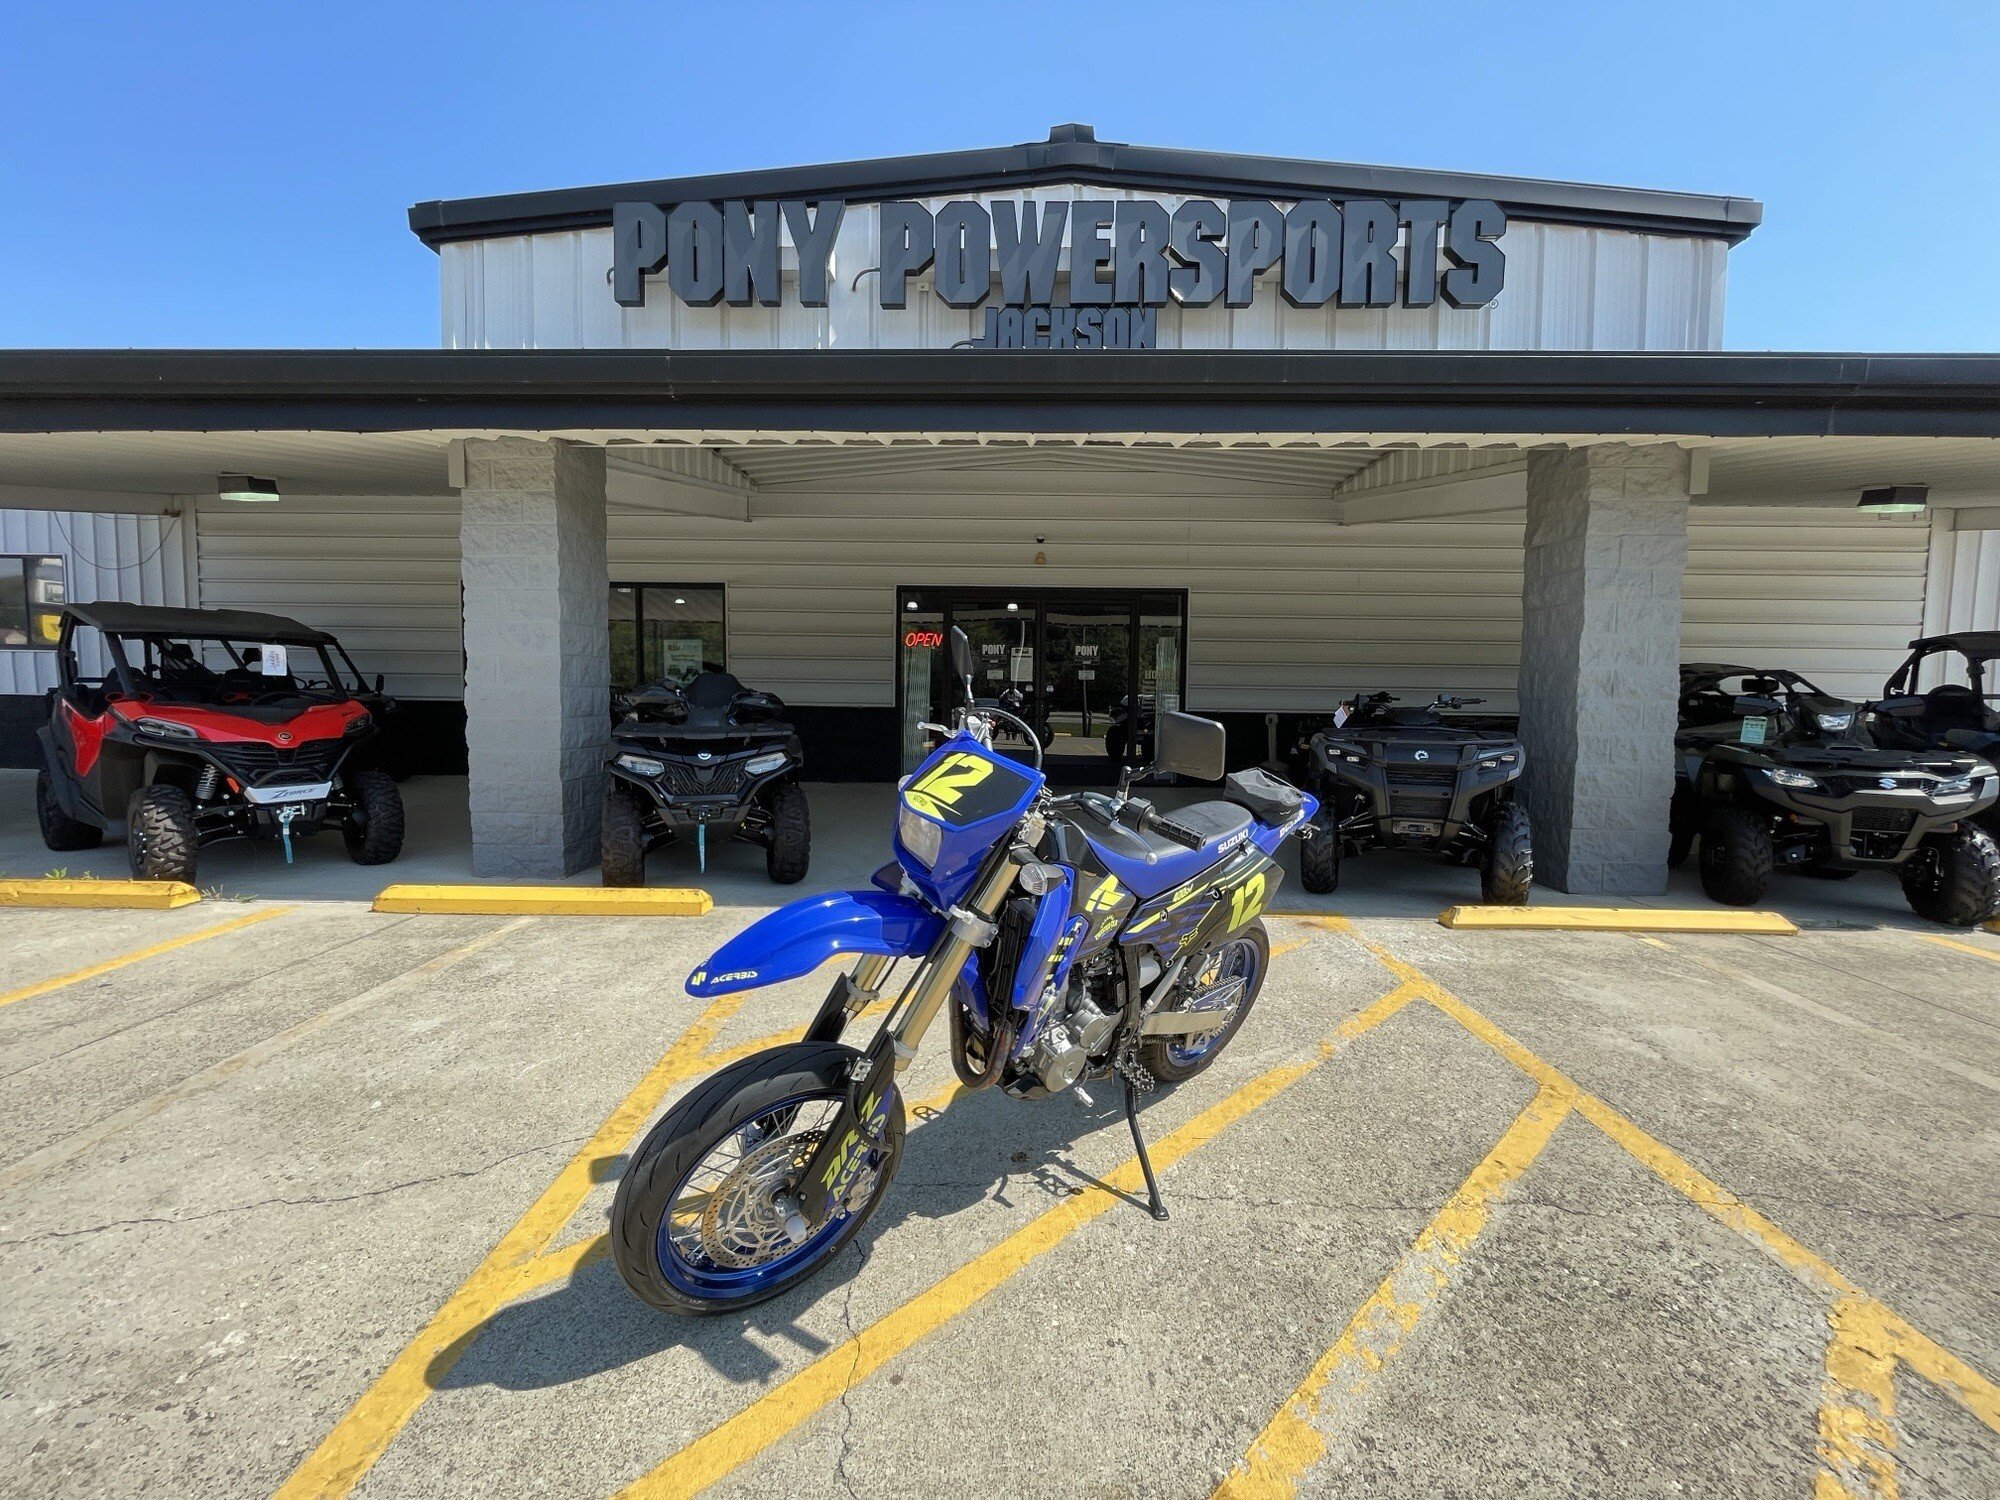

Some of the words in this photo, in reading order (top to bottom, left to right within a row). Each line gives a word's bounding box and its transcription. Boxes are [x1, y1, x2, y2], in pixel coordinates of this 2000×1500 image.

[613, 199, 846, 307] PONY
[879, 199, 1506, 309] POWERSPORTS
[971, 307, 1157, 349] JACKSON
[905, 632, 944, 647] OPEN
[982, 644, 1006, 655] PONY
[1075, 645, 1099, 656] PONY
[912, 752, 994, 805] 12
[1217, 828, 1249, 854] SUZUKI
[1227, 872, 1266, 934] 12
[710, 970, 758, 985] ACERBIS
